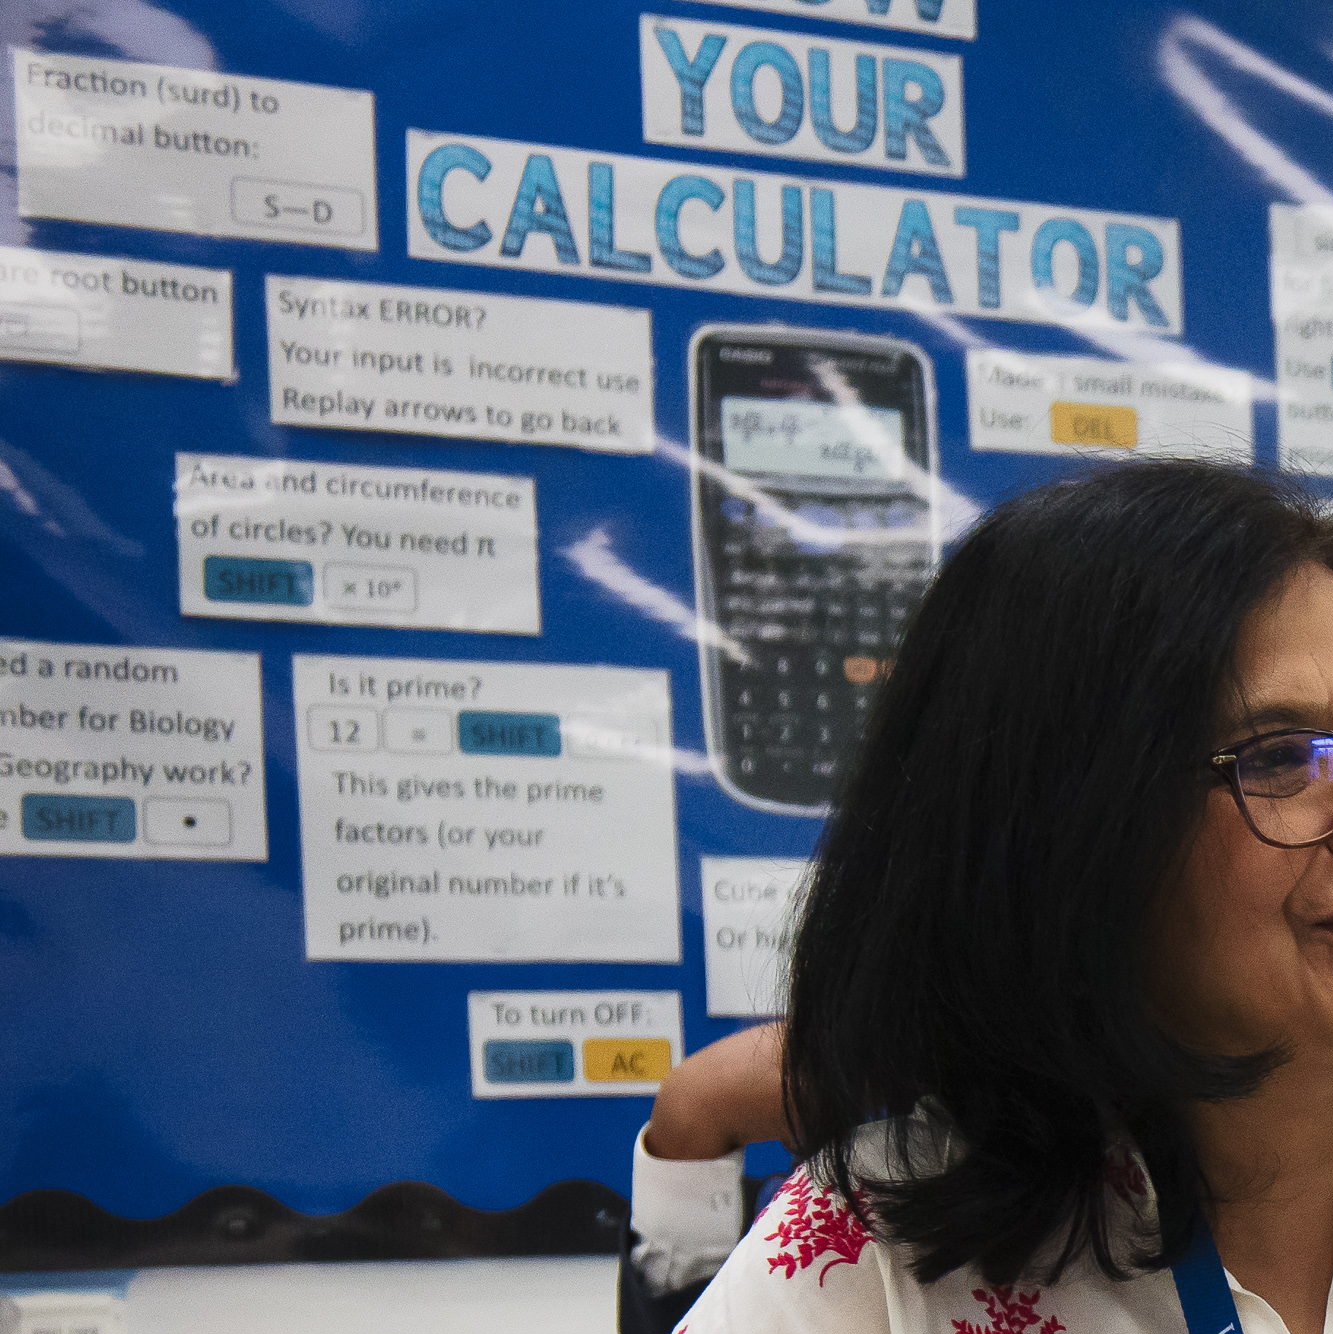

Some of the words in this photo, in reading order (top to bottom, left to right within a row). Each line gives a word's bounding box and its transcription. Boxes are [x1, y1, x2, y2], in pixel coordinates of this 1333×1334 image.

[27, 63, 147, 97] Fraction
[156, 76, 241, 111] (surd)
[250, 92, 279, 114] to
[653, 26, 952, 167] YOUR
[28, 112, 145, 145] decimal
[154, 124, 259, 159] button:
[417, 143, 1170, 328] CALCULATOR
[52, 269, 112, 294] root
[122, 270, 217, 303] button
[279, 290, 370, 320] Syntax
[379, 299, 487, 329] ERROR?
[280, 341, 341, 366] Your
[353, 350, 424, 374] input
[433, 356, 452, 375] is
[469, 356, 588, 388] incorrect
[597, 373, 640, 394] use
[283, 387, 374, 418] Replay
[385, 399, 476, 424] arrows
[486, 405, 512, 427] to
[522, 412, 552, 434] go
[561, 409, 621, 436] back
[190, 466, 255, 490] Area
[266, 472, 316, 494] and
[326, 474, 521, 510] circumference
[191, 516, 219, 539] of
[228, 519, 333, 545] circles?
[342, 523, 390, 551] You
[400, 533, 467, 557] need
[217, 570, 295, 597] SHIFT
[38, 658, 54, 678] a
[64, 657, 179, 683] random
[329, 673, 349, 694] Is
[359, 675, 376, 695] it
[386, 677, 483, 701] prime?
[78, 705, 120, 732] for
[129, 707, 236, 742] Biology
[329, 720, 360, 744] 12
[472, 725, 545, 748] SHIFT
[162, 758, 252, 786] work?
[333, 771, 387, 797] This
[397, 774, 465, 801] gives
[474, 777, 517, 799] the
[527, 780, 604, 803] prime
[36, 806, 119, 834] SHIFT
[335, 818, 428, 844] factors
[437, 820, 474, 850] (or
[484, 827, 544, 850] your
[336, 871, 440, 900] original
[449, 873, 553, 896] number
[563, 872, 581, 896] if
[338, 916, 439, 945] prime).
[492, 1003, 521, 1026] To
[530, 1005, 585, 1026] turn
[493, 1051, 565, 1076] SHIFT
[610, 1050, 646, 1077] AC
